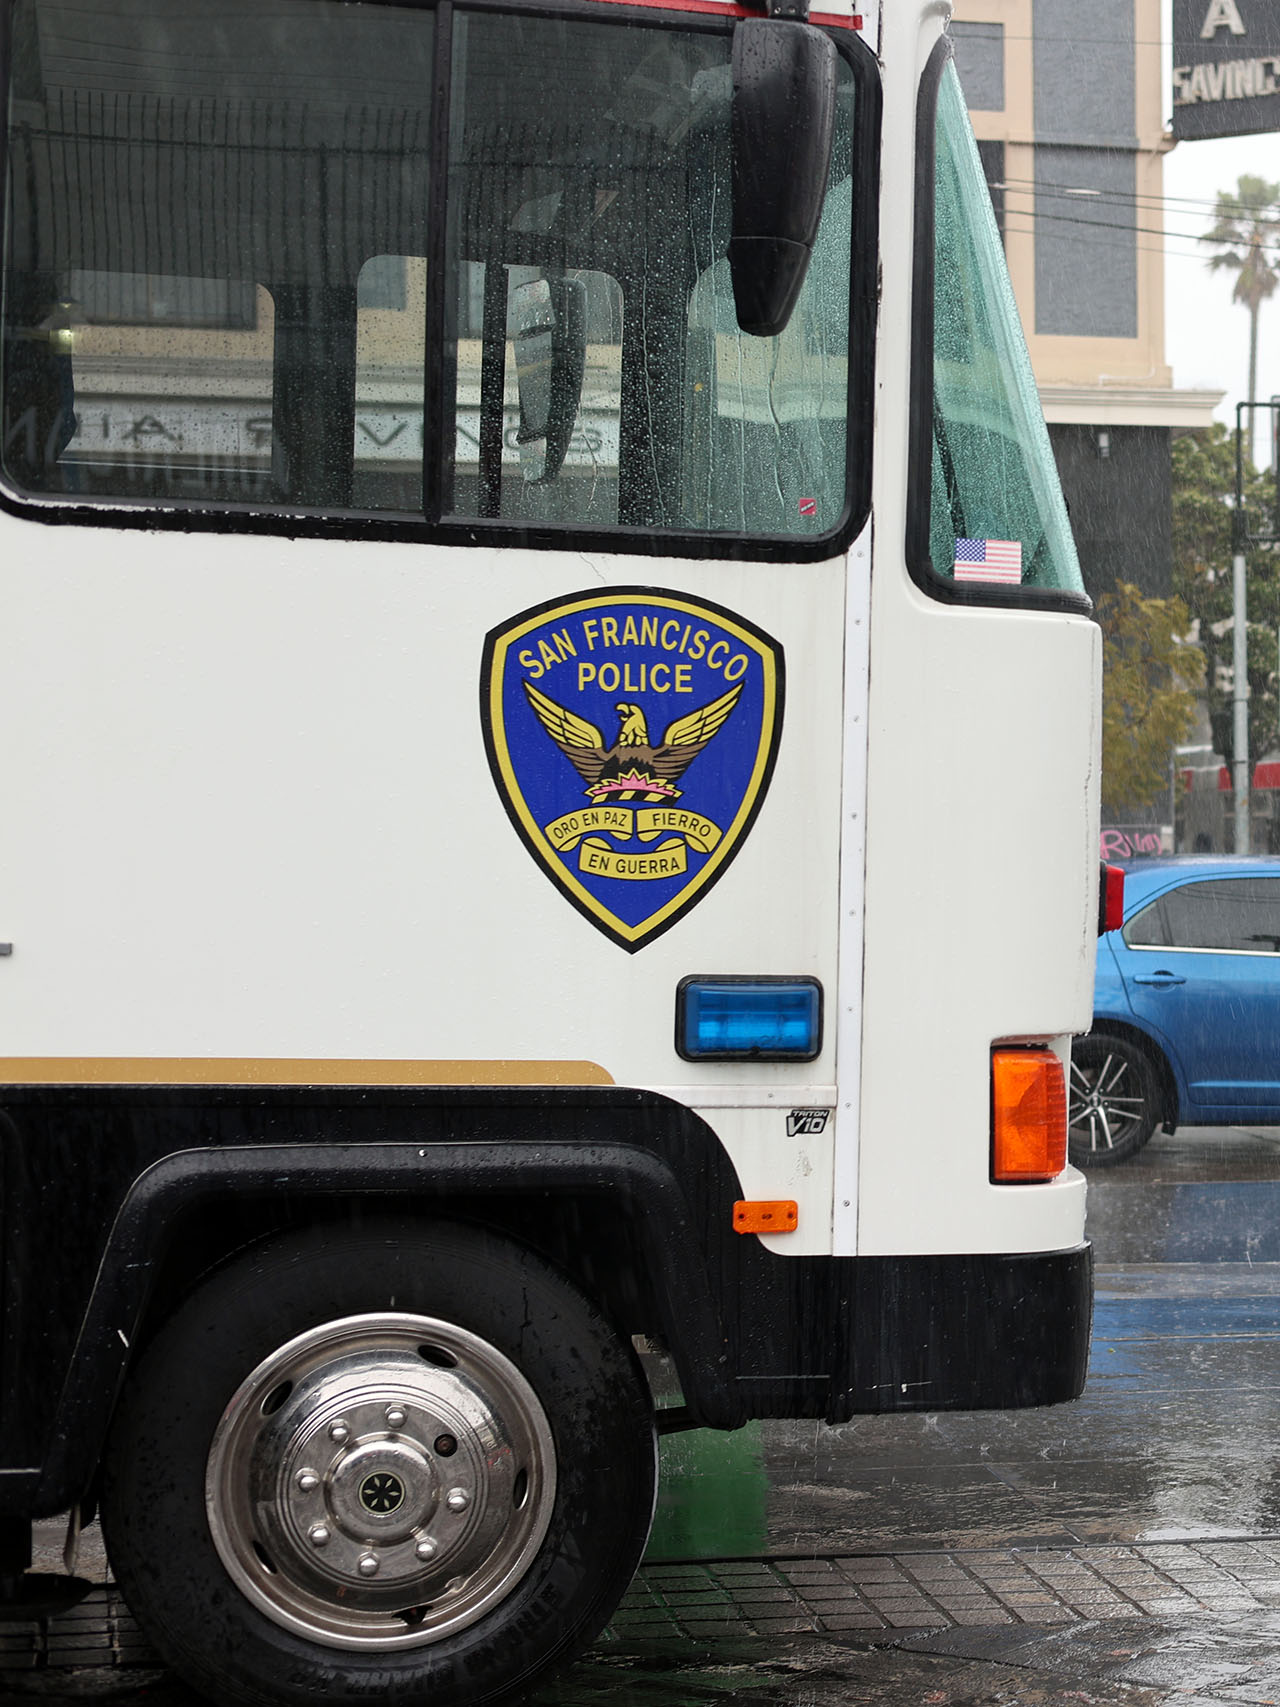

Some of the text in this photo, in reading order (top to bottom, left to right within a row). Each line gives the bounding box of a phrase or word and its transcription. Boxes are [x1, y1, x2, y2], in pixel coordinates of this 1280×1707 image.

[1201, 0, 1246, 39] A
[519, 615, 749, 682] SAN FRANCISCO
[578, 662, 693, 693] POLICE
[553, 811, 628, 840] ORO EN PAZ
[652, 812, 711, 838] FIERRO
[588, 853, 680, 874] EN GUERRA
[788, 1116, 825, 1136] V10
